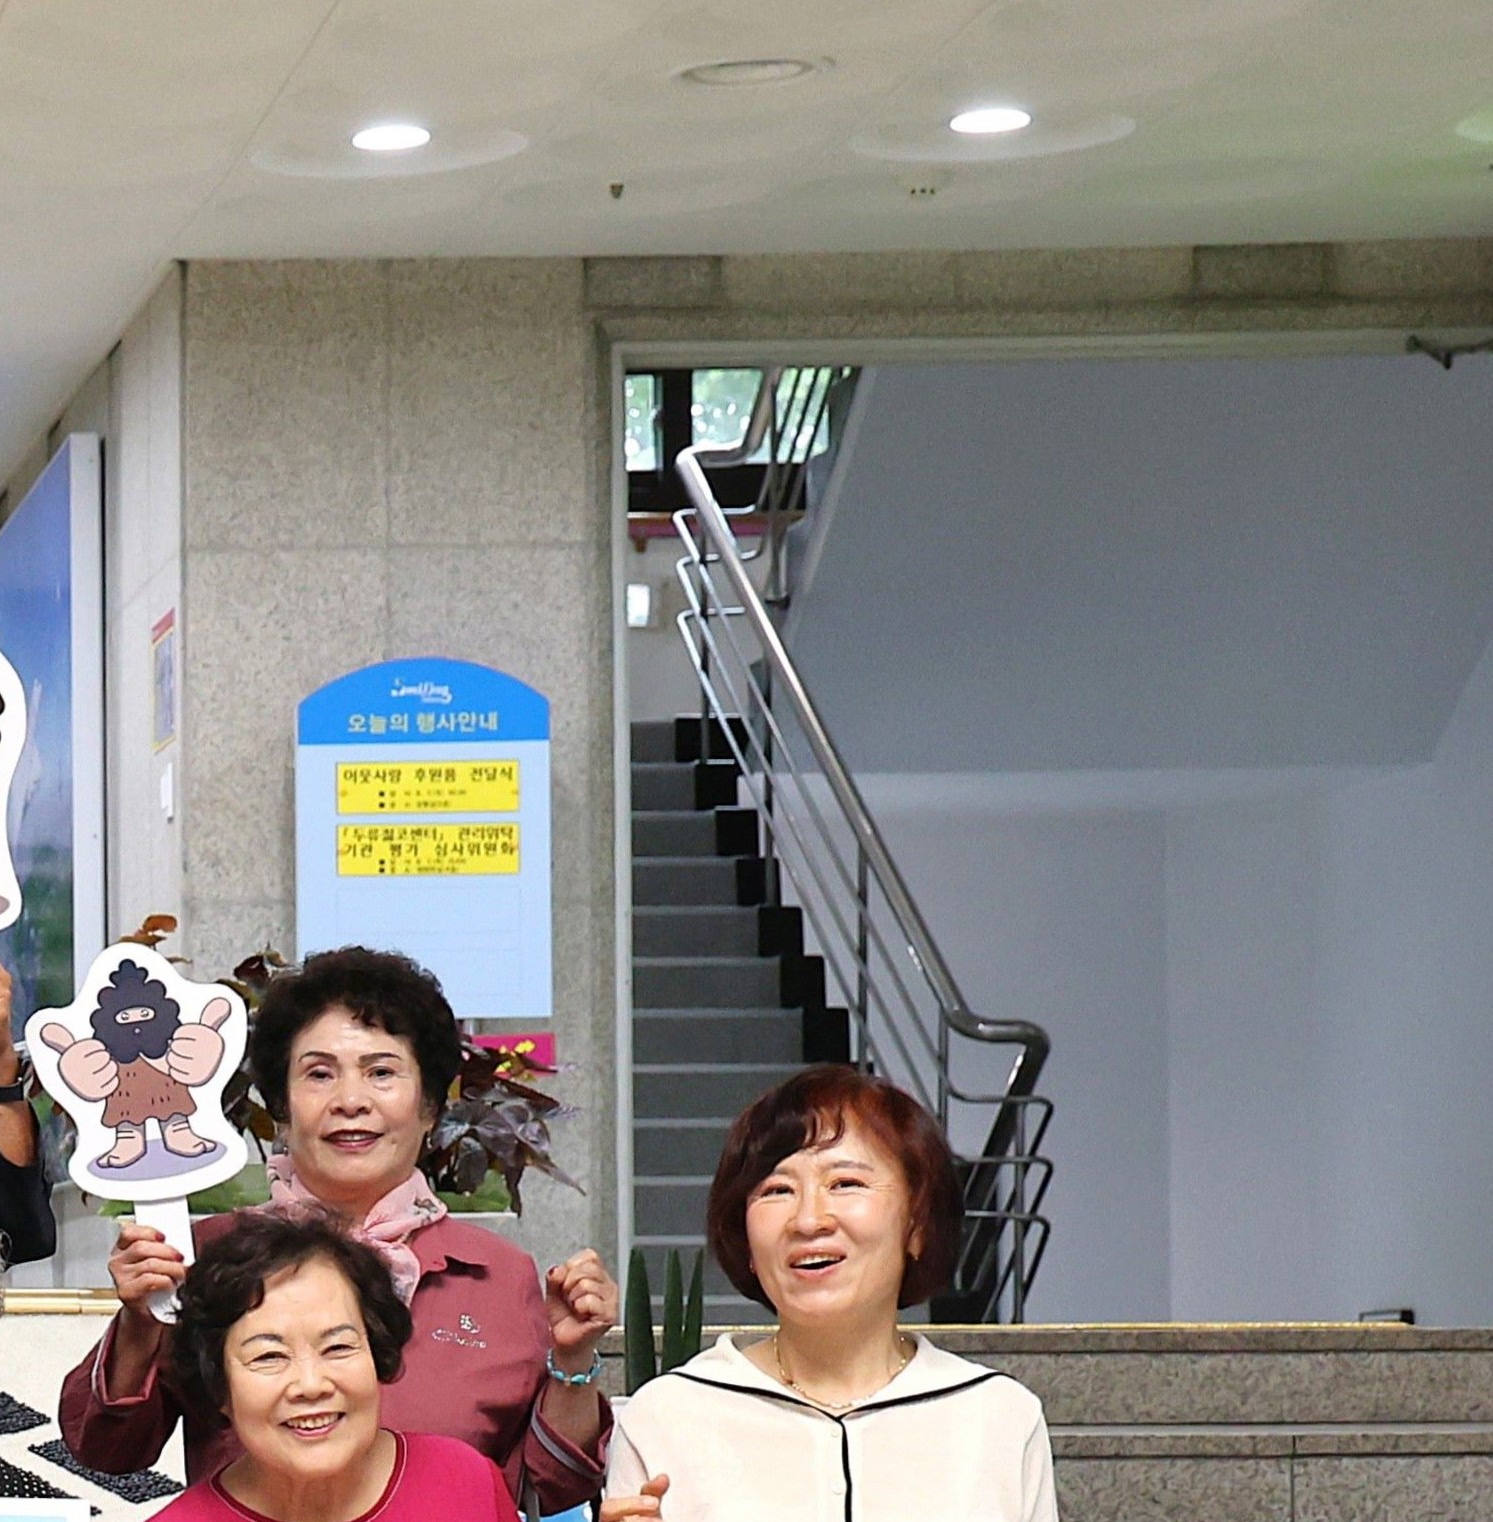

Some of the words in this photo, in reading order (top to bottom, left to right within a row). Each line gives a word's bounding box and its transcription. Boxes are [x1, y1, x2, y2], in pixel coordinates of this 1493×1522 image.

[348, 713, 409, 734] 오늘의
[416, 711, 498, 733] 행사안내
[343, 768, 402, 785] 이웃사랑
[414, 767, 456, 783] 후원품
[470, 766, 513, 782] 전달식
